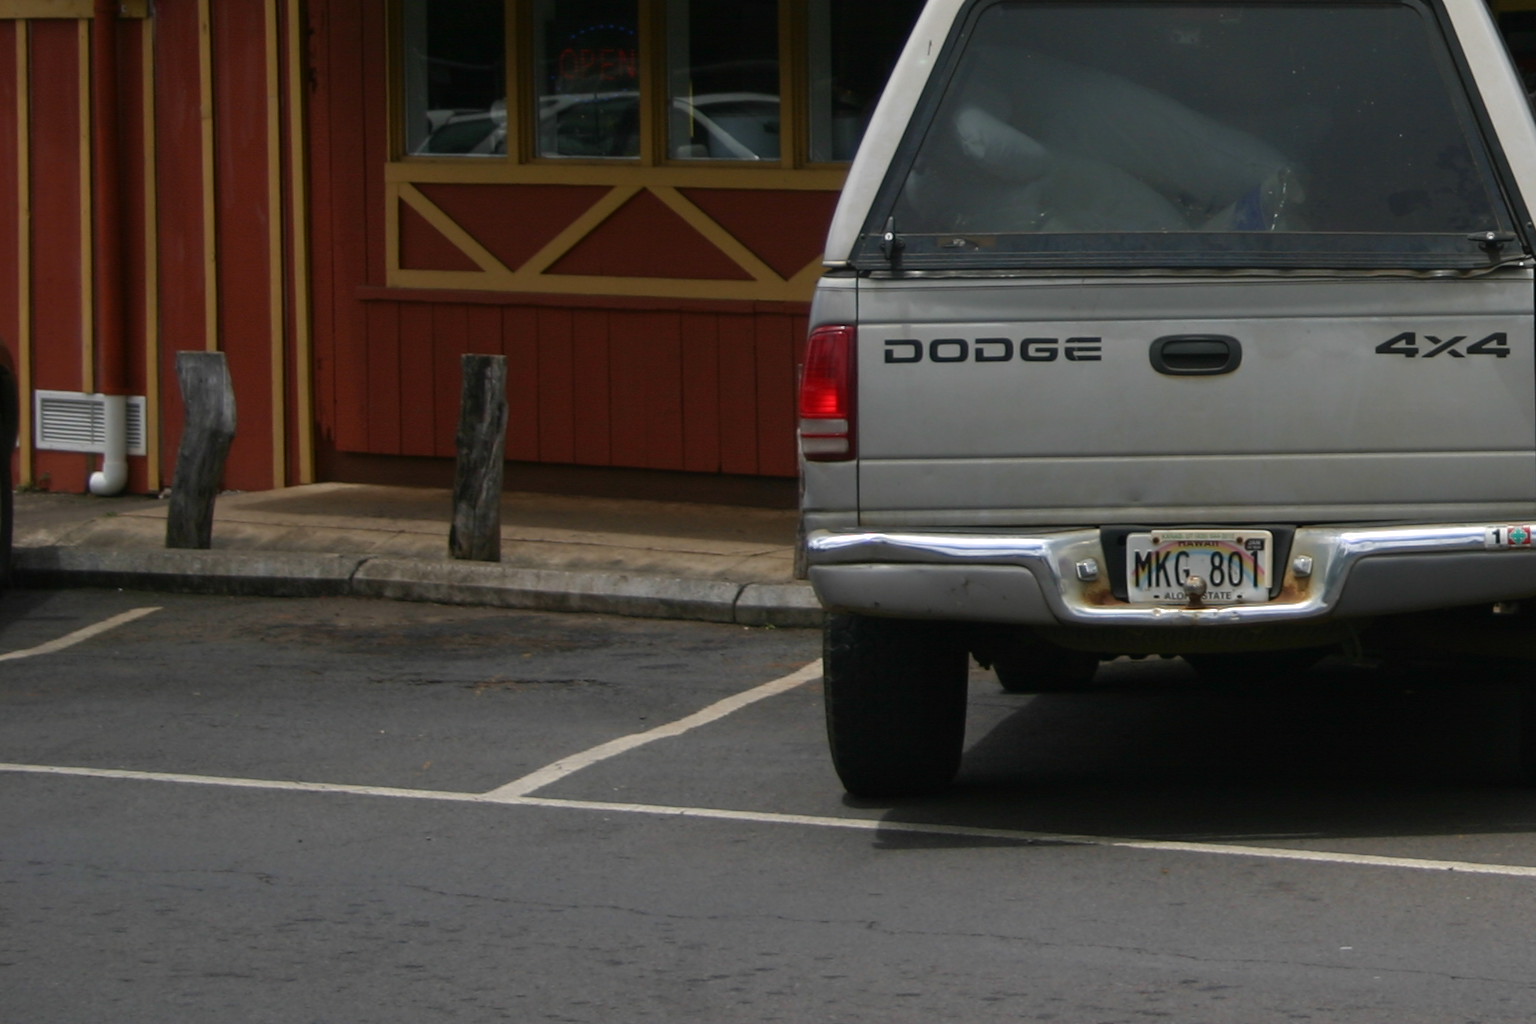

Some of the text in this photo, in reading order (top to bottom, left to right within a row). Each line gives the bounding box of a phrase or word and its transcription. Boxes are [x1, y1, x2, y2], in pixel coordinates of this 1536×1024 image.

[559, 48, 637, 81] OPEN
[884, 337, 1102, 364] DODGE
[1134, 550, 1259, 588] MKG 801
